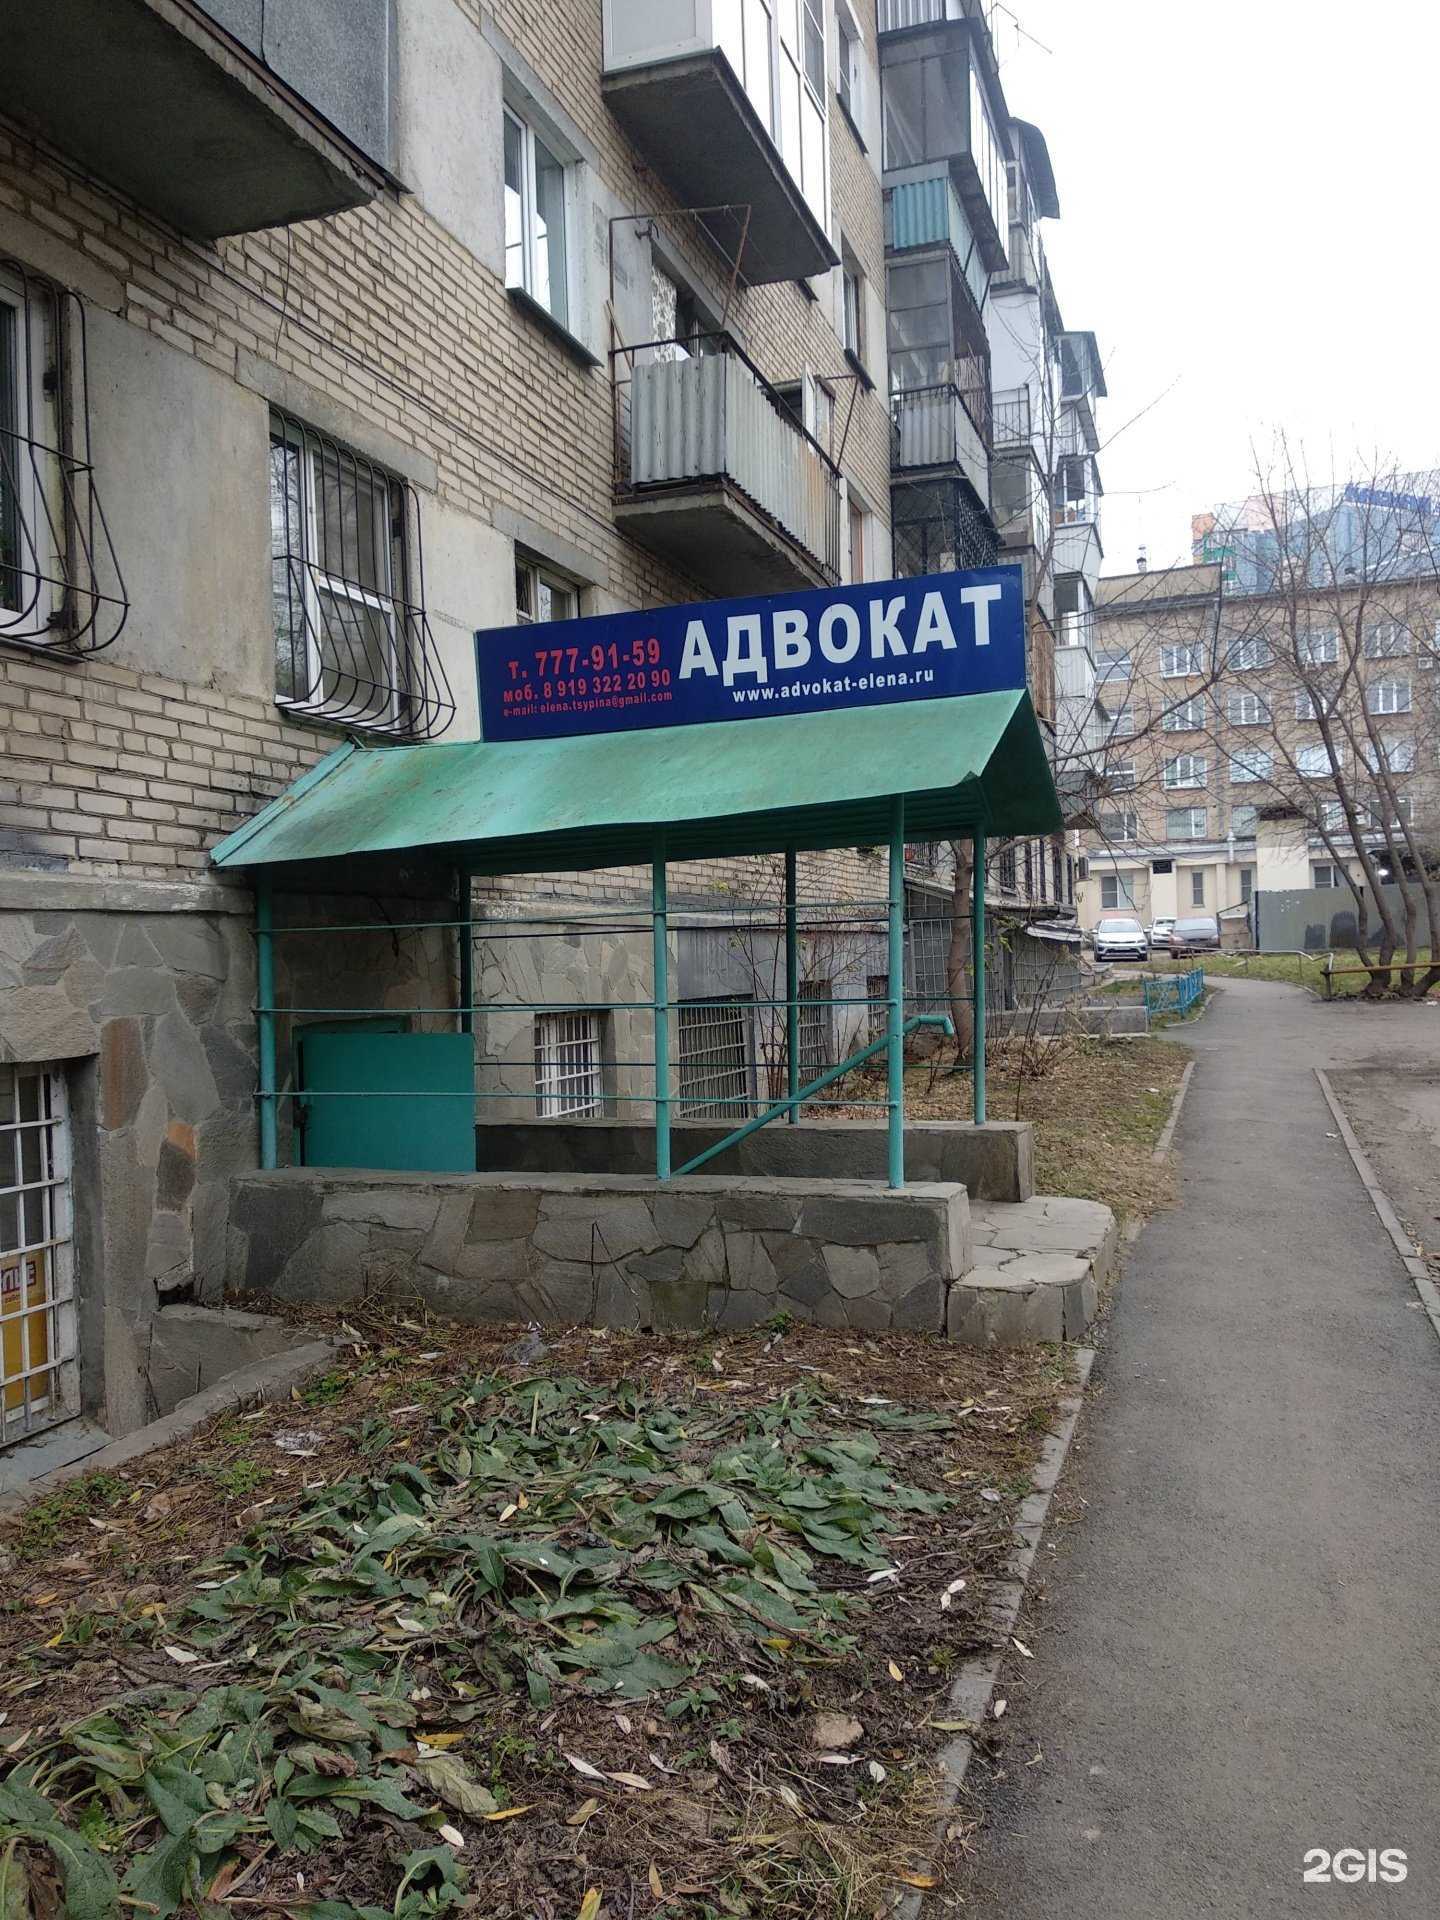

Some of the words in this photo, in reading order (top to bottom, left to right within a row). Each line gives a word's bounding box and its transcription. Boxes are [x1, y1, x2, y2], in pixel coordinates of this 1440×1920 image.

[678, 583, 1002, 687] АДВОКАТ
[535, 638, 661, 677] 777-91-59
[503, 683, 539, 703] моб.
[543, 681, 552, 699] 8
[557, 678, 588, 697] 919
[592, 674, 622, 694] 322
[627, 671, 646, 690] 20
[651, 668, 671, 687] 90
[732, 667, 935, 703] www.advokat-elena.ru
[503, 703, 538, 717] e-mail:
[540, 691, 673, 712] elena.tsypina@gmail.com
